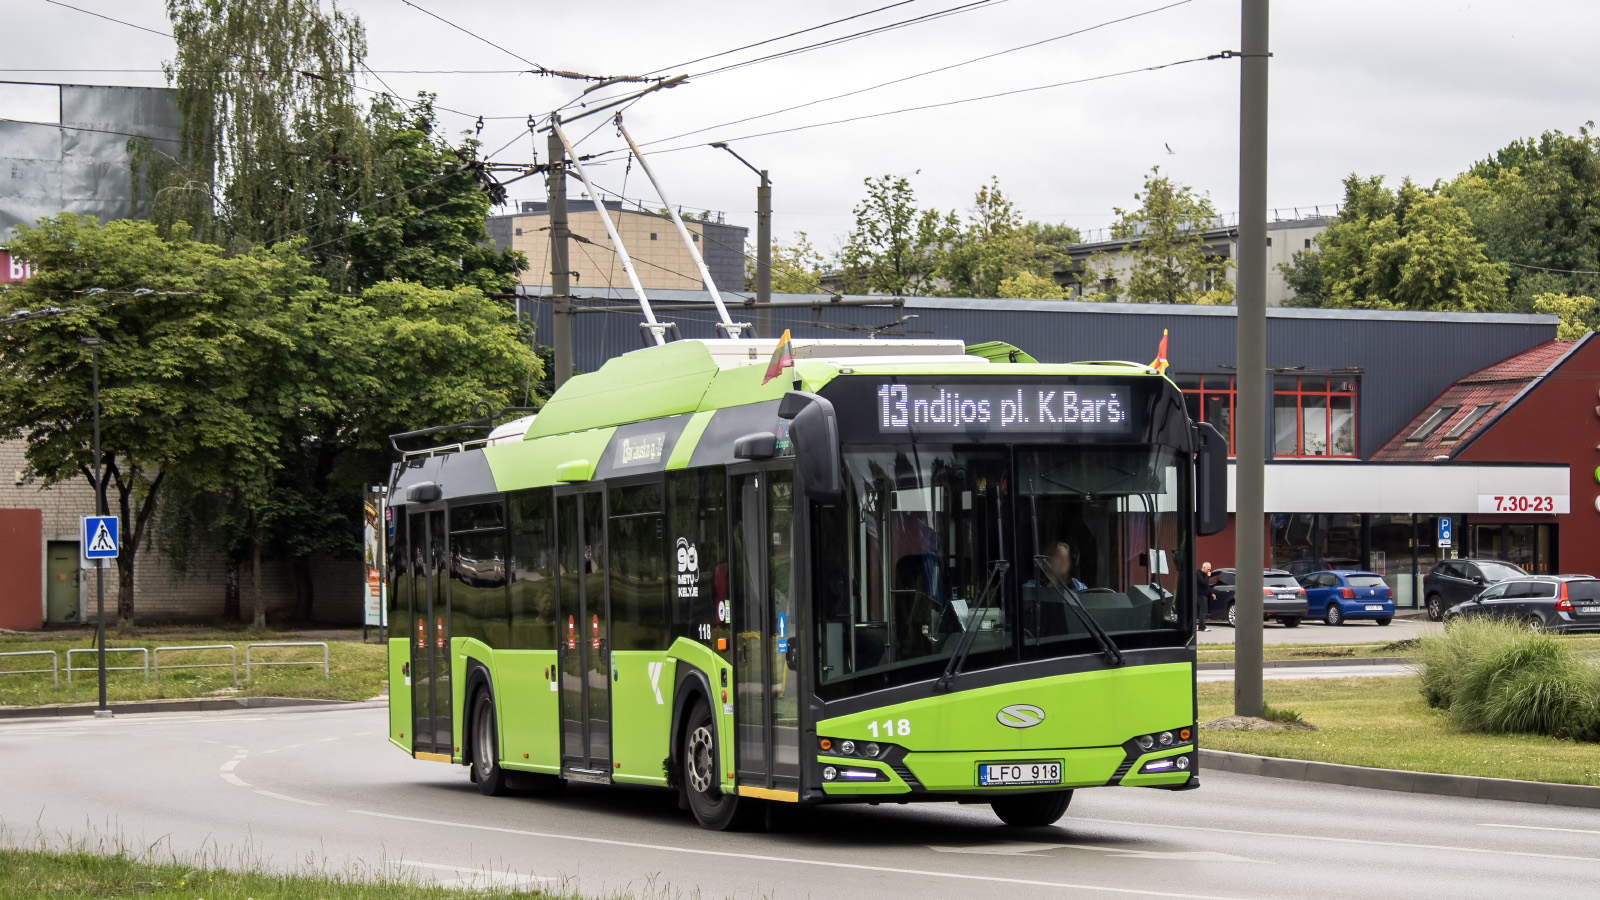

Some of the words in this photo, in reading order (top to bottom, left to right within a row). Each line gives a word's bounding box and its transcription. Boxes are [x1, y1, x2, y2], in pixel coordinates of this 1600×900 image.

[879, 384, 908, 427] 13
[914, 388, 990, 427] ndijos
[1000, 388, 1029, 427] pl.
[1494, 496, 1554, 512] 7.30-23
[1441, 518, 1449, 531] P
[677, 544, 699, 573] 90
[678, 587, 699, 598] KELYJE
[698, 623, 712, 640] 118
[867, 718, 911, 738] 118
[989, 766, 1021, 781] LFO
[1031, 764, 1058, 779] 918
